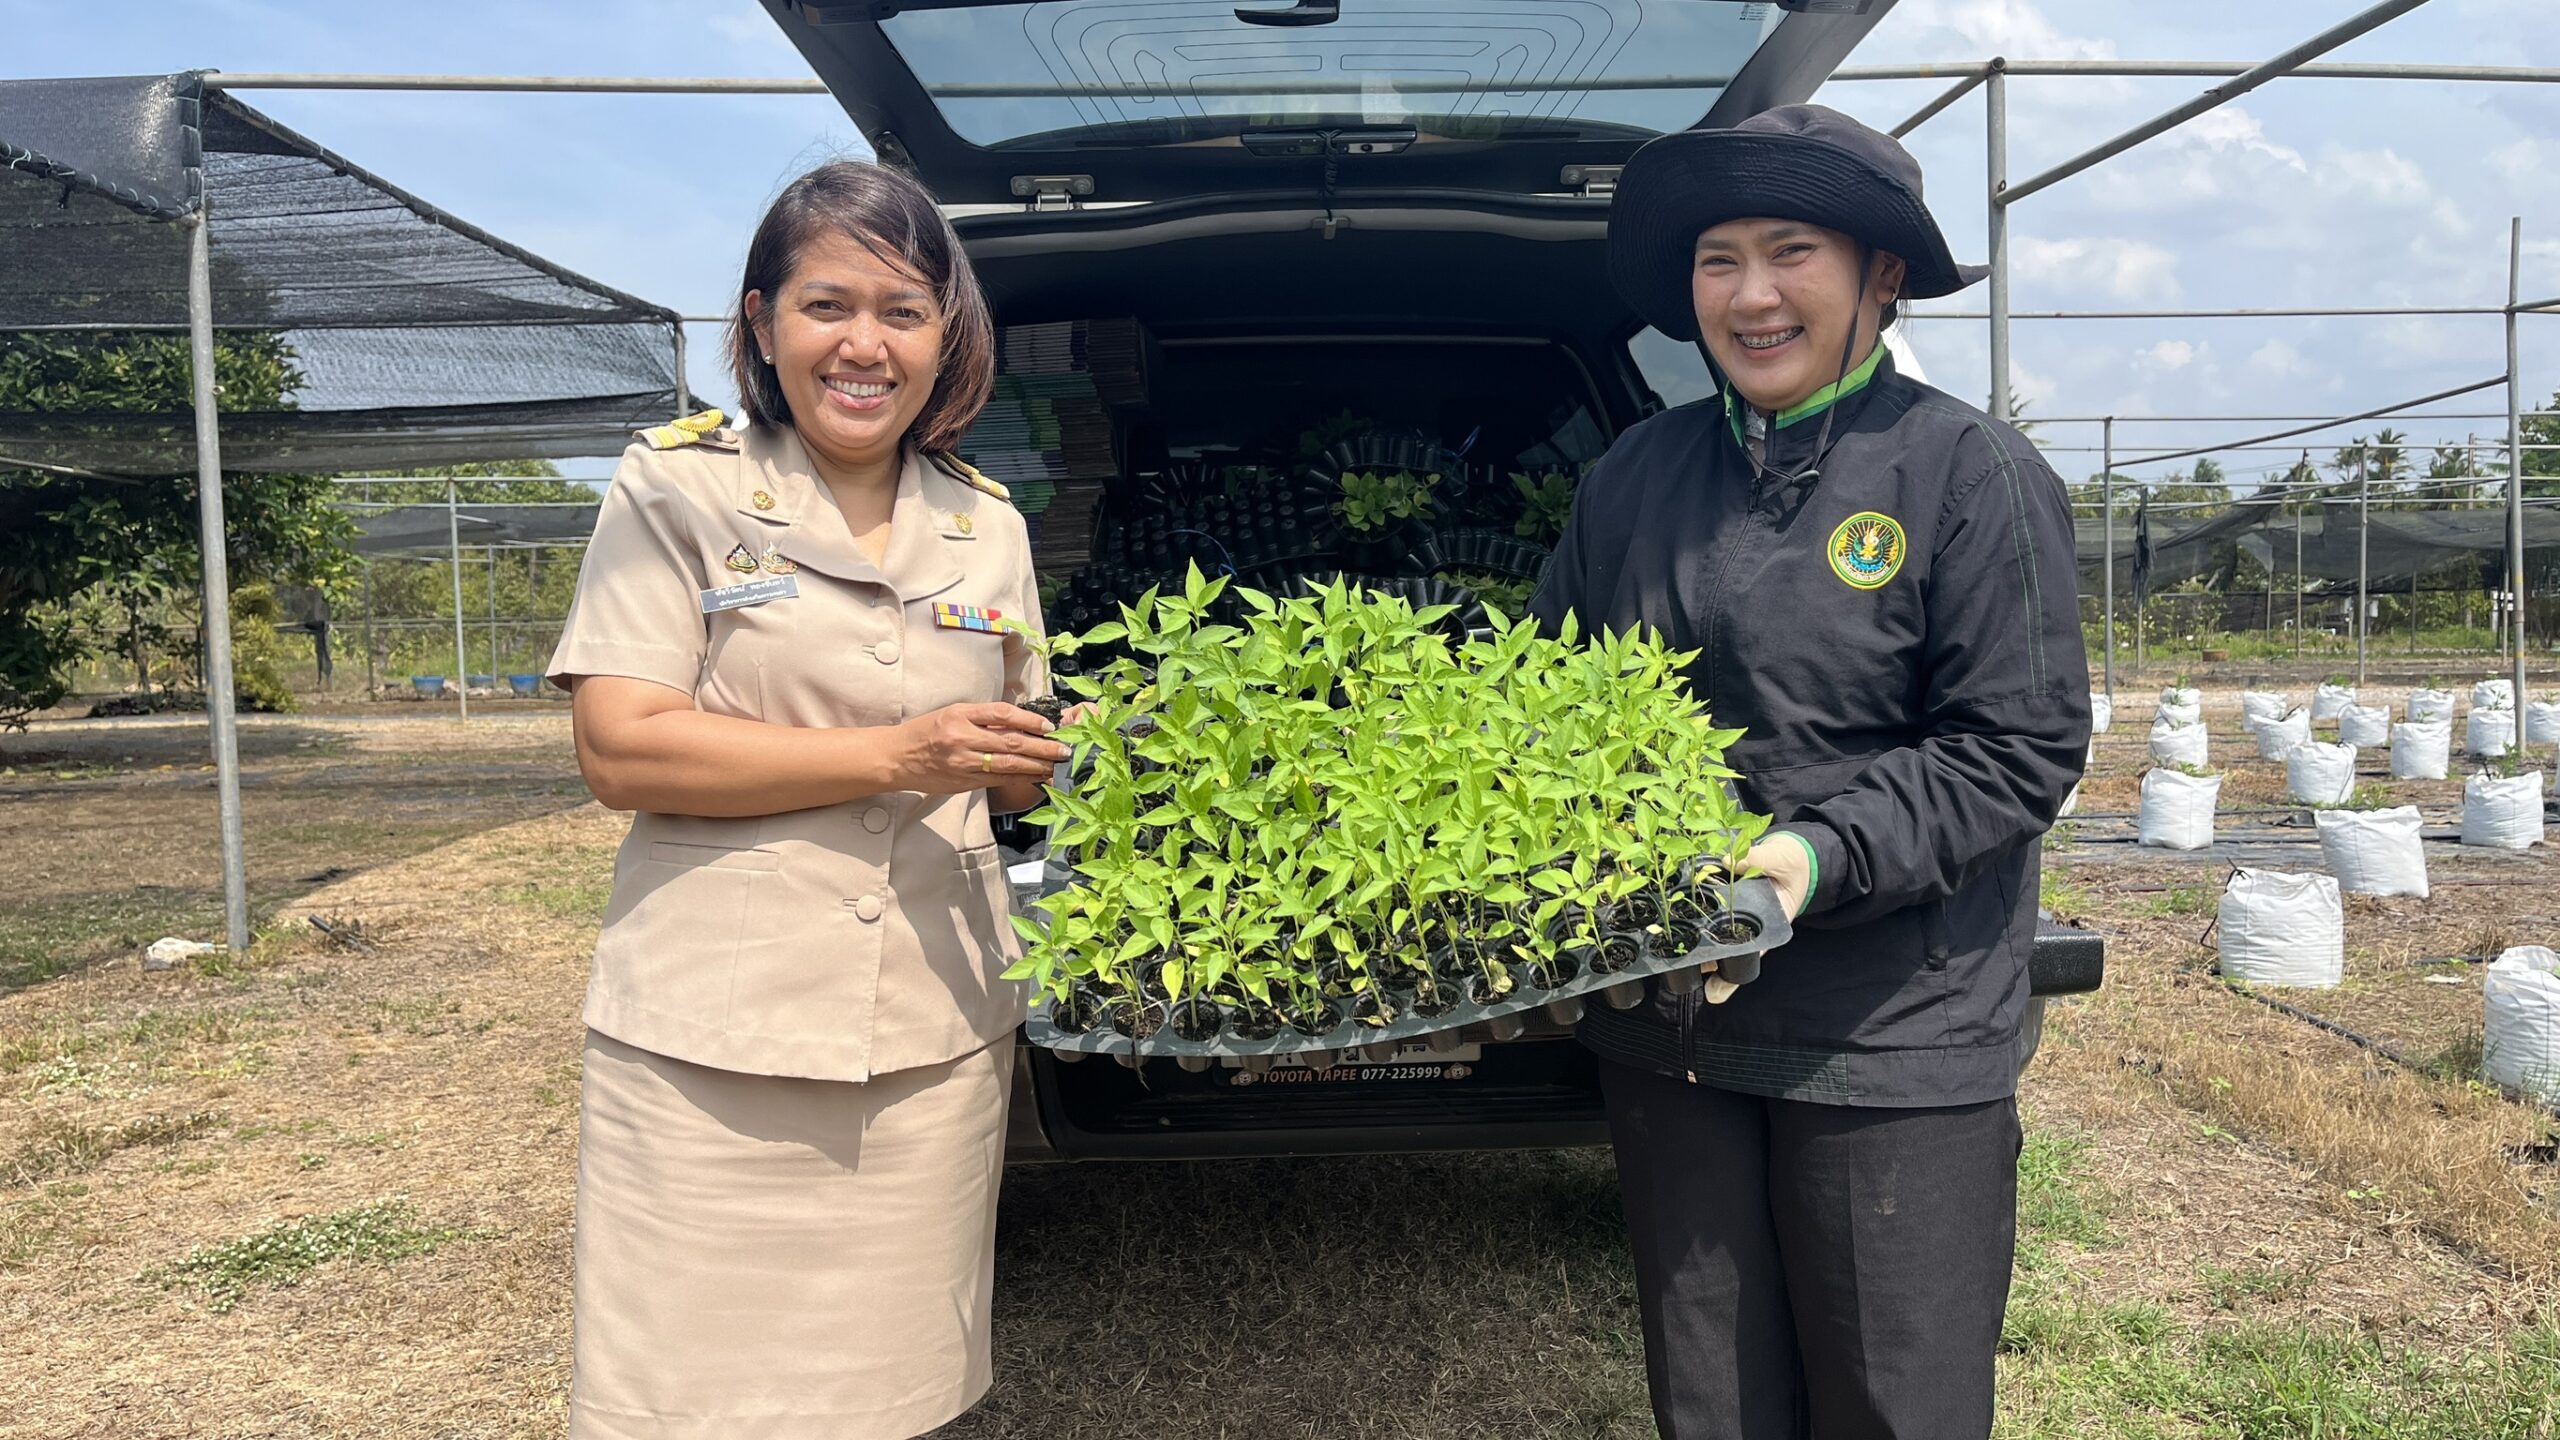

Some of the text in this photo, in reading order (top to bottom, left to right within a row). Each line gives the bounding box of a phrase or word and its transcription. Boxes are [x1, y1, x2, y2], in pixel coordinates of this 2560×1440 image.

[1262, 1066, 1441, 1083] TOYOTA TAPEE 077-225999
